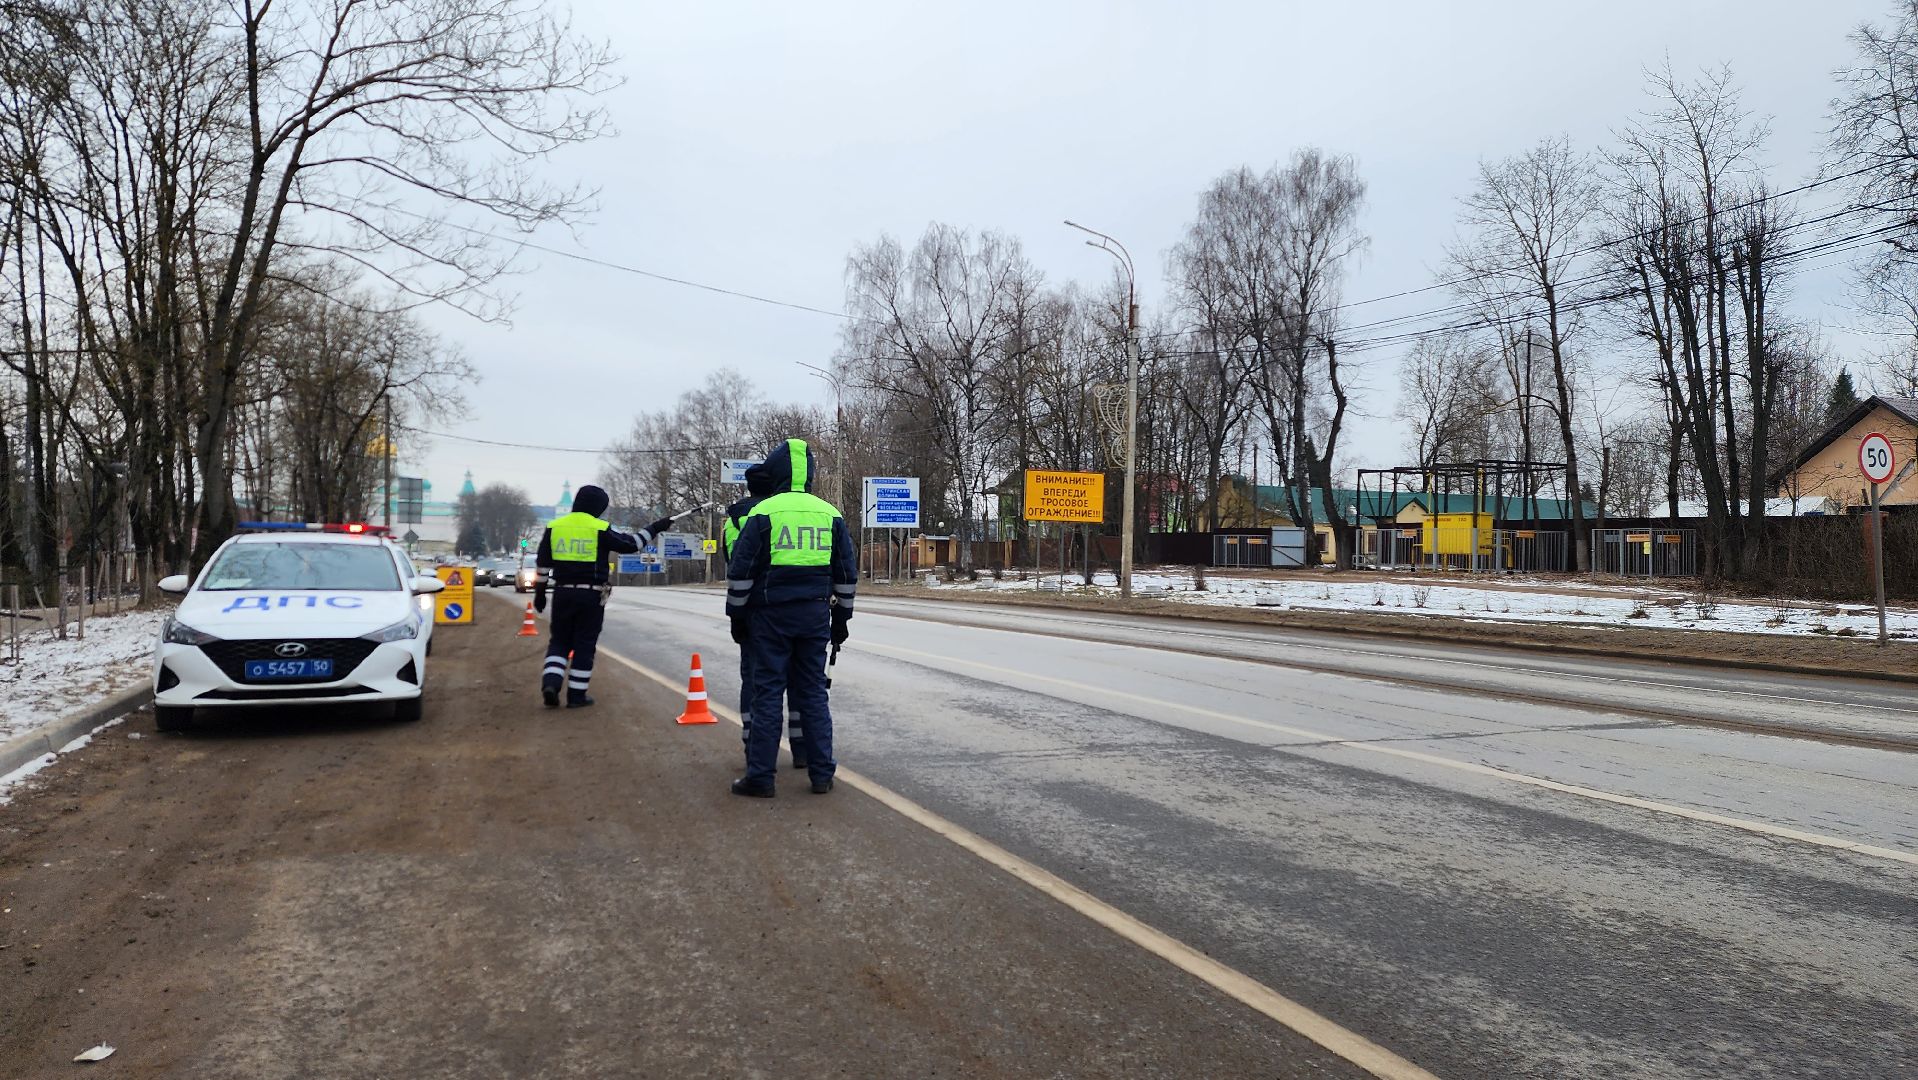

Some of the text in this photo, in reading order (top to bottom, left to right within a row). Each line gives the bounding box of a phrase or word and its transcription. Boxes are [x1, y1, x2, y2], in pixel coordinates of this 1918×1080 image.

[1867, 448, 1887, 467] 50
[1035, 475, 1095, 485] ВНИМАНИЕ!!!
[1043, 488, 1087, 498] ВПЕРЕДИ
[1040, 498, 1089, 507] ТРОСОВОЕ
[1028, 507, 1101, 518] ОГРАЖДЕНИЕ!!!
[774, 525, 832, 551] ДПС
[555, 538, 593, 554] ДПС
[222, 595, 363, 613] ДПС
[268, 662, 305, 675] 5457
[313, 661, 328, 671] 50
